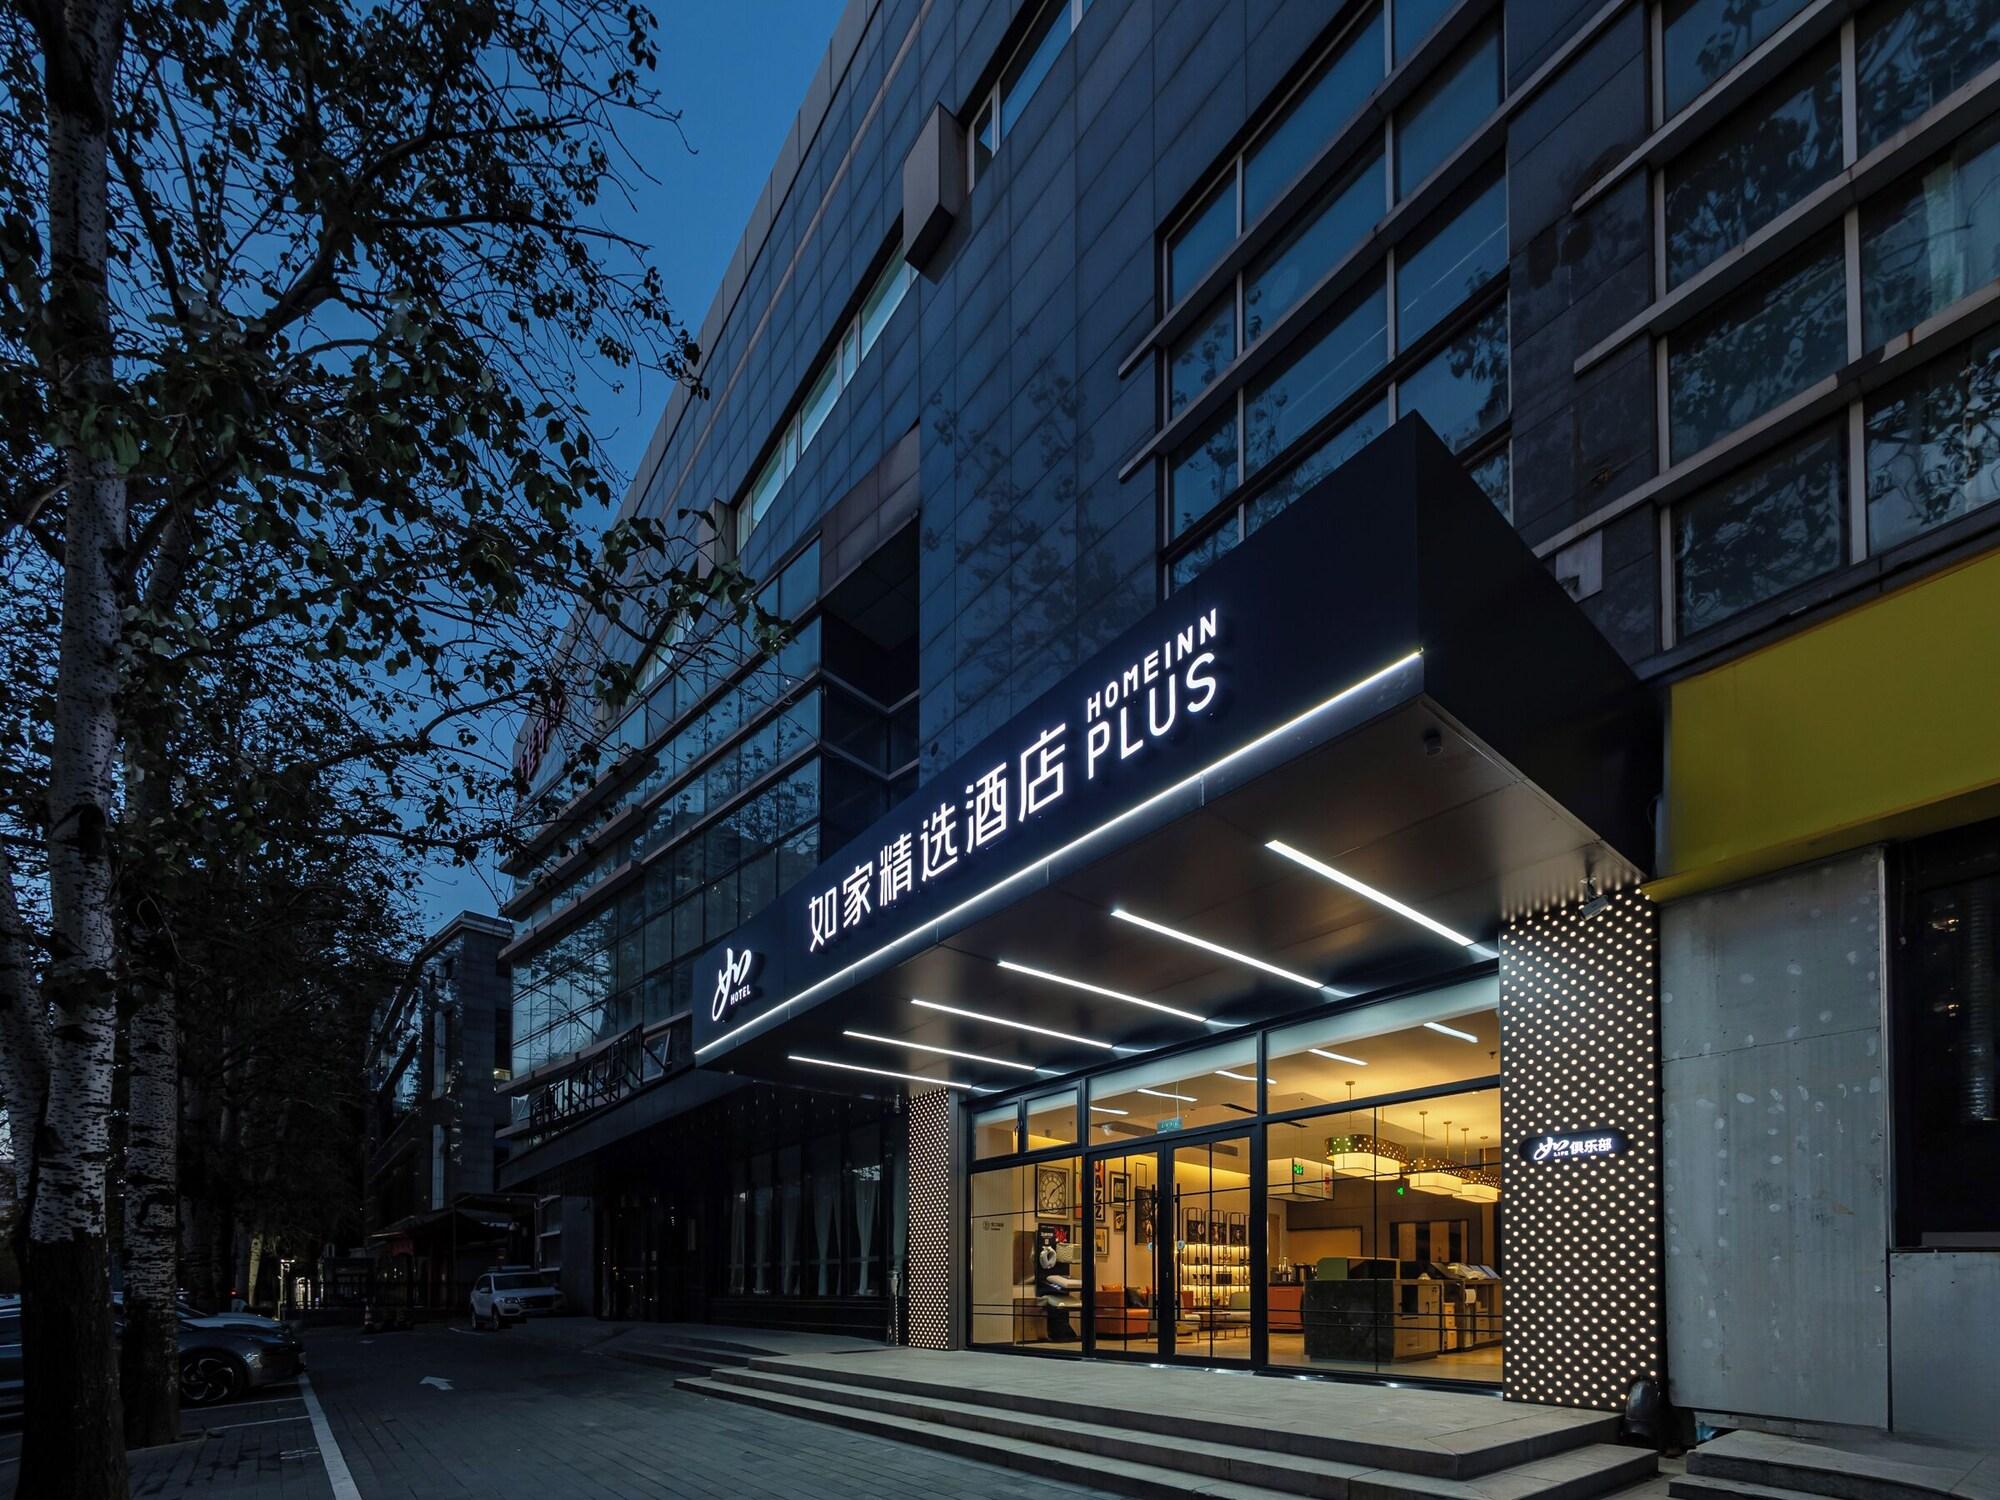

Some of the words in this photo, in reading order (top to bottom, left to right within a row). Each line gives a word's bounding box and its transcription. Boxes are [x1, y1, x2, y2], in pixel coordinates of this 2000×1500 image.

[1087, 652, 1217, 780] PLUS
[808, 722, 1066, 953] 如家精选酒店
[730, 984, 752, 1005] HOTEL
[1570, 1137, 1612, 1154] 俱乐部
